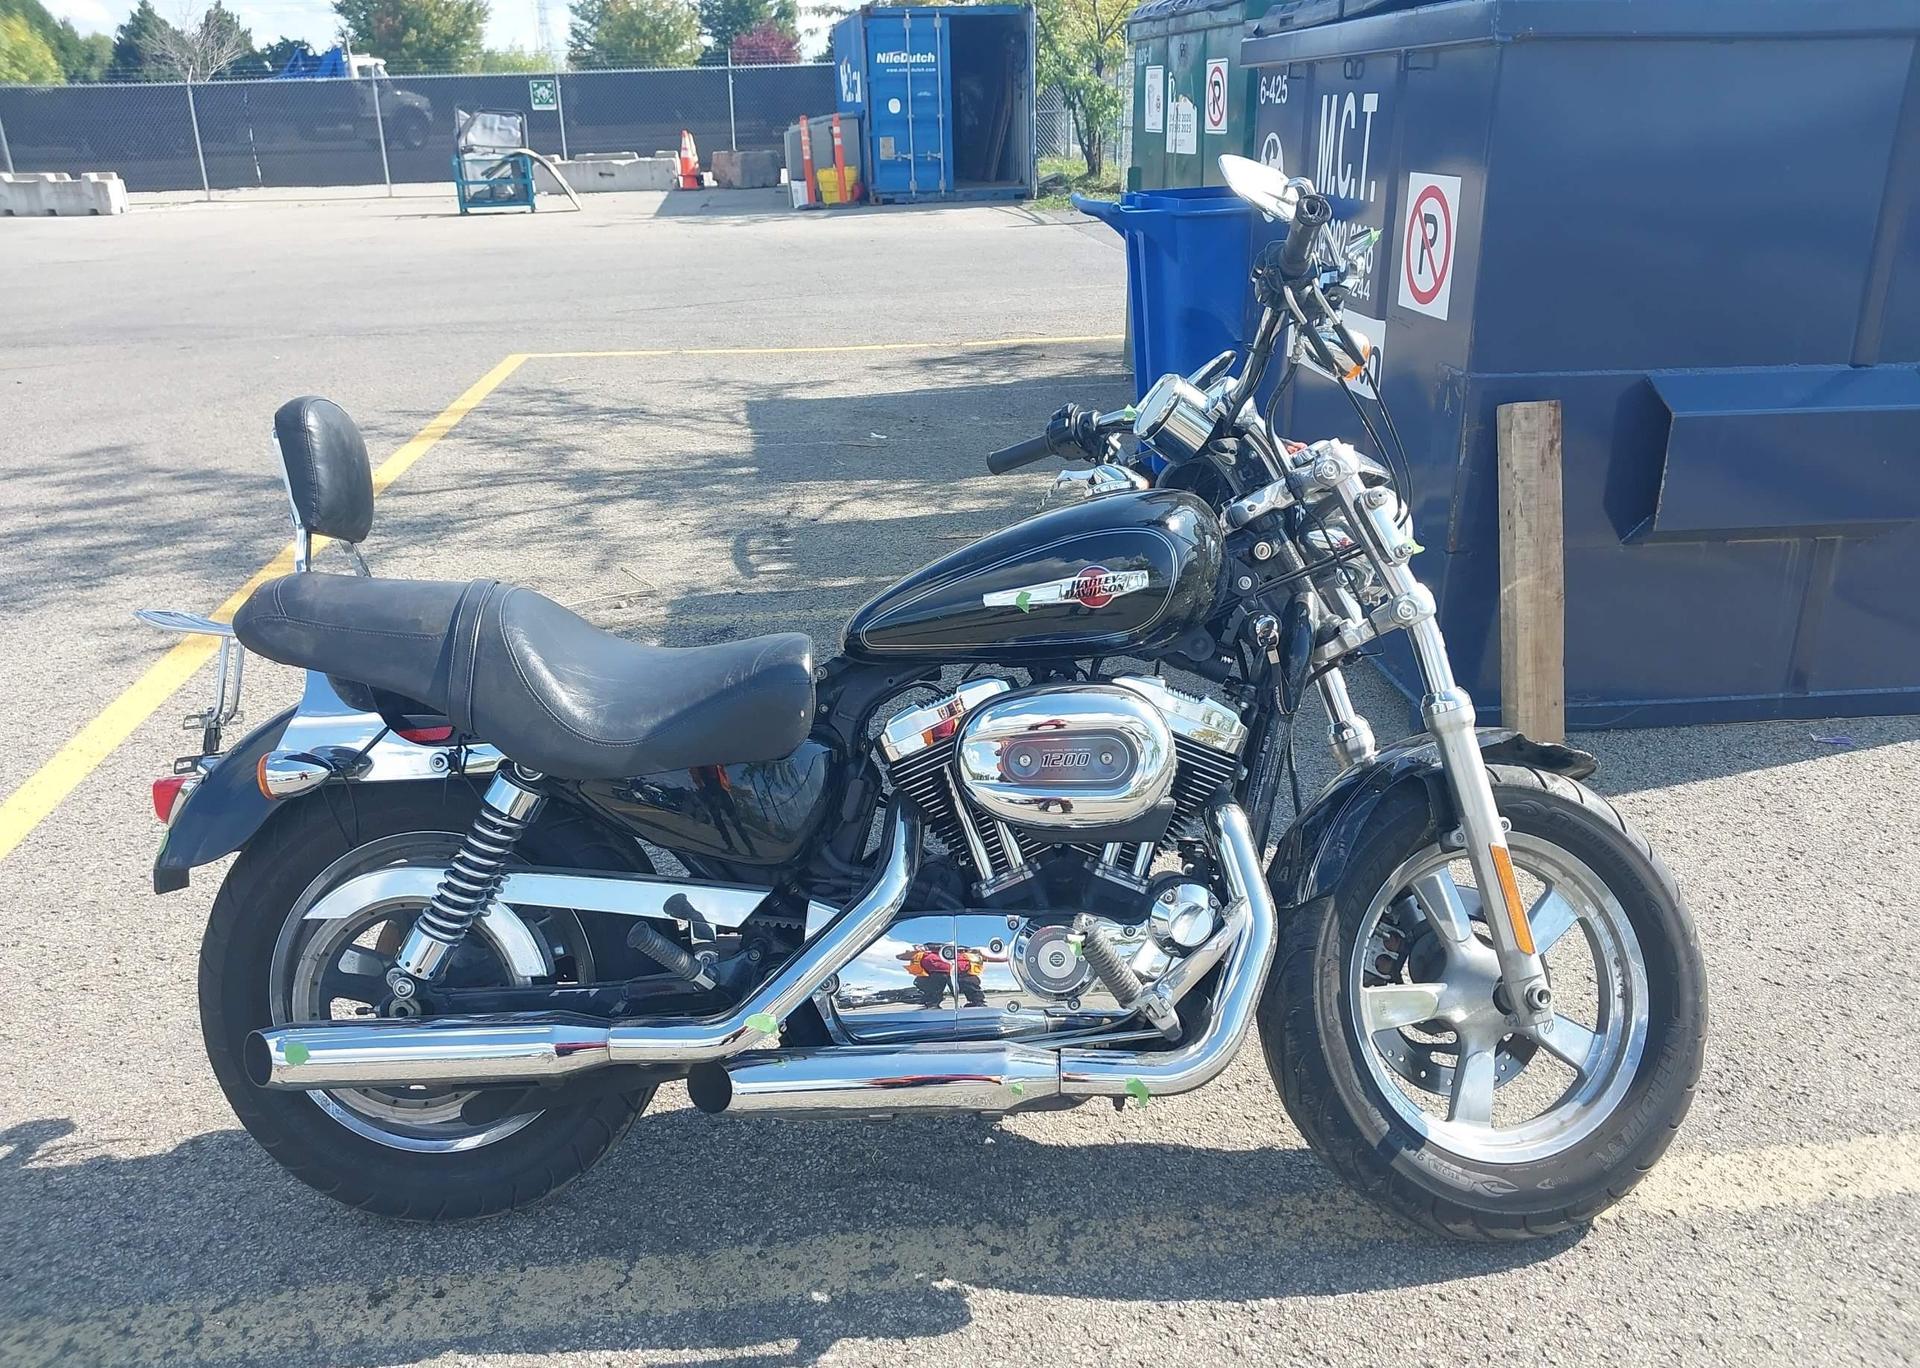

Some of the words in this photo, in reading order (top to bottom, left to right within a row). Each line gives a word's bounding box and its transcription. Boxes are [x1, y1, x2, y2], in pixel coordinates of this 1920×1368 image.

[1260, 75, 1288, 105] 6-425
[1316, 91, 1379, 203] M.C.T.
[1063, 583, 1125, 600] DAVIDSON
[1041, 752, 1091, 768] 1200
